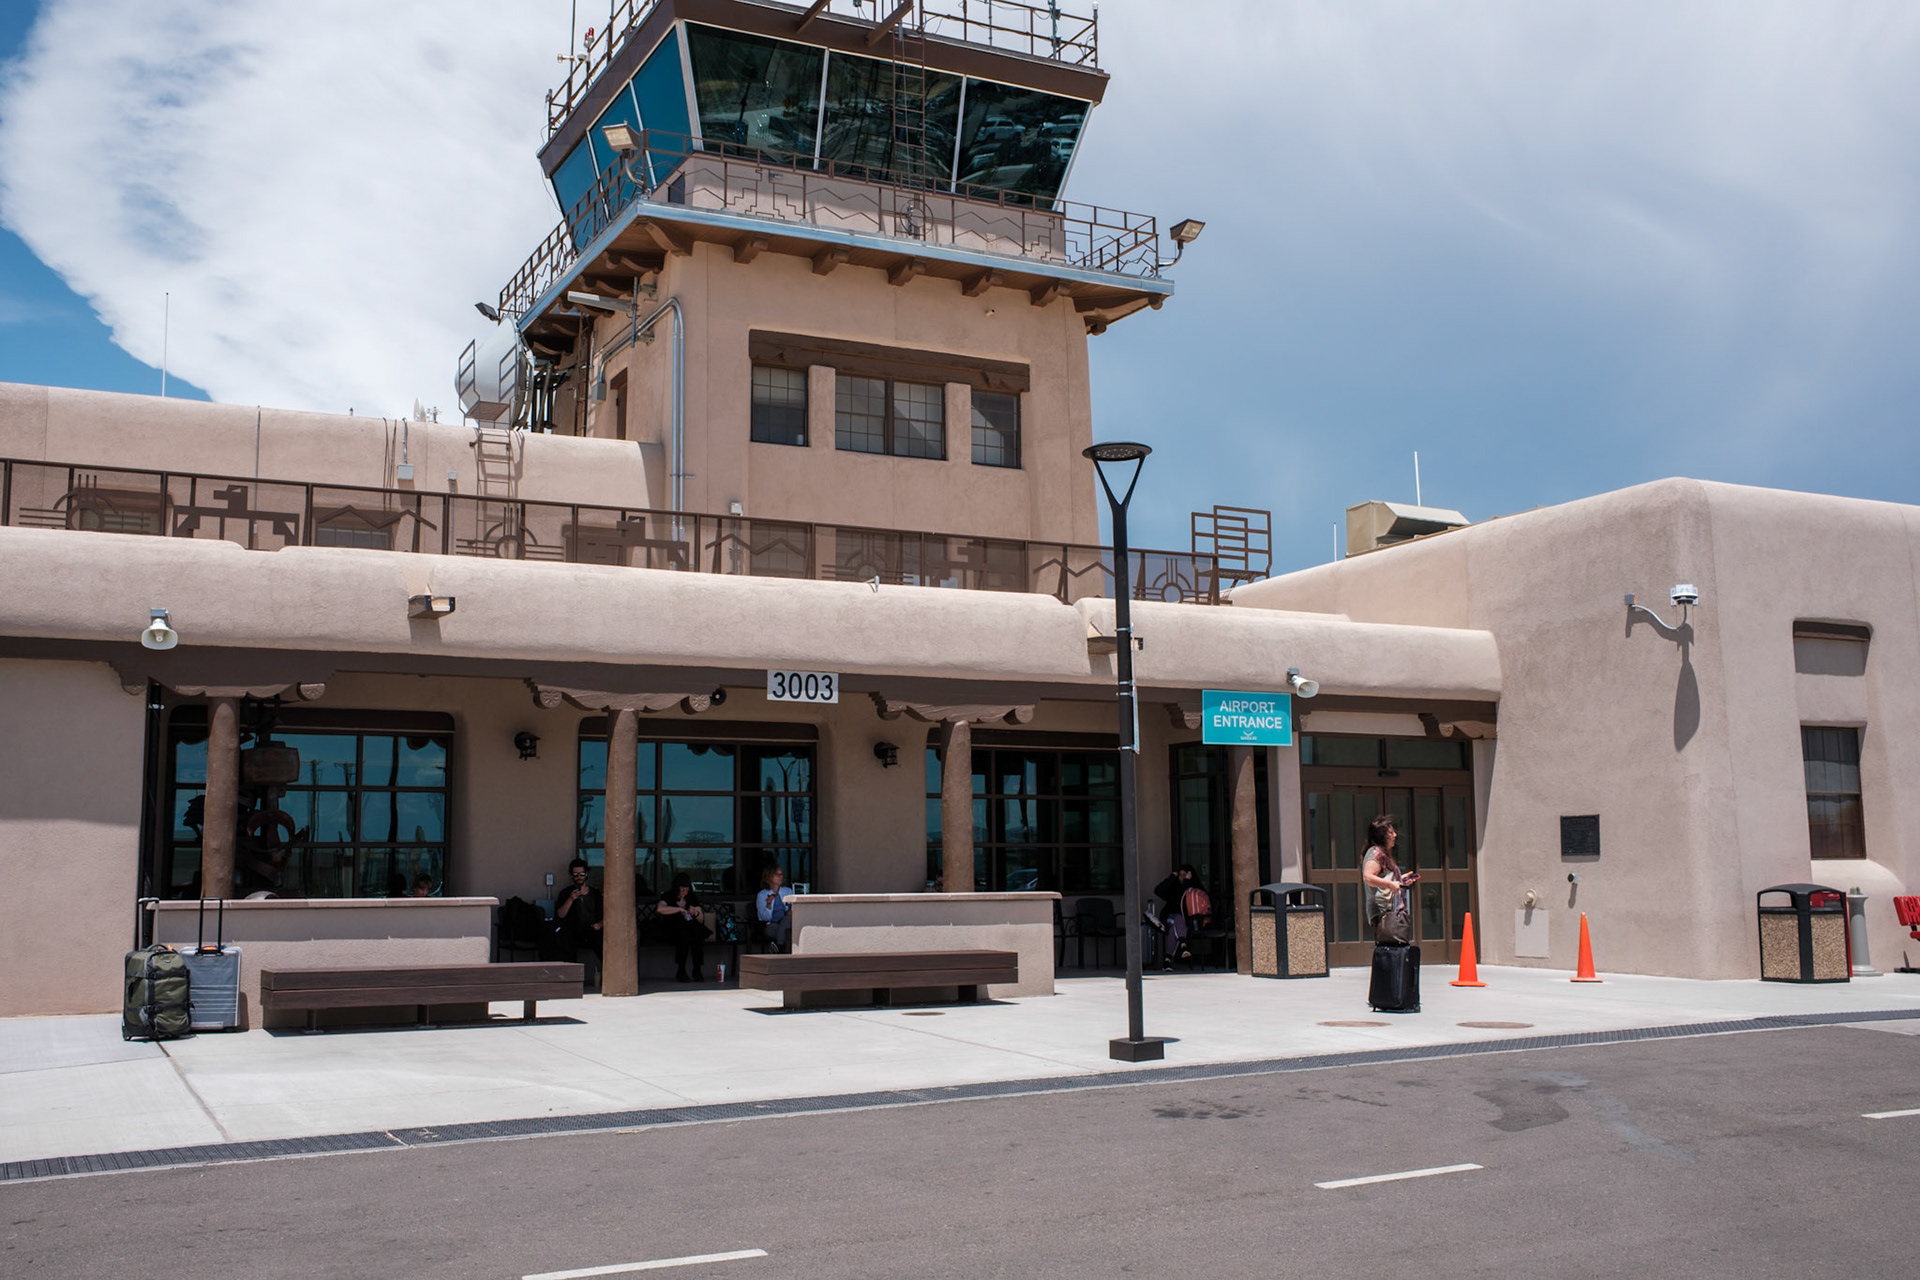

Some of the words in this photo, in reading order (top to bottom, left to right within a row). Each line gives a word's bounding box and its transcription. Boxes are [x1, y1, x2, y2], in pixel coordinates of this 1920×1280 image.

[772, 672, 833, 700] 3003
[1220, 700, 1275, 713] AIRPORT
[1213, 715, 1282, 729] ENTRANCE
